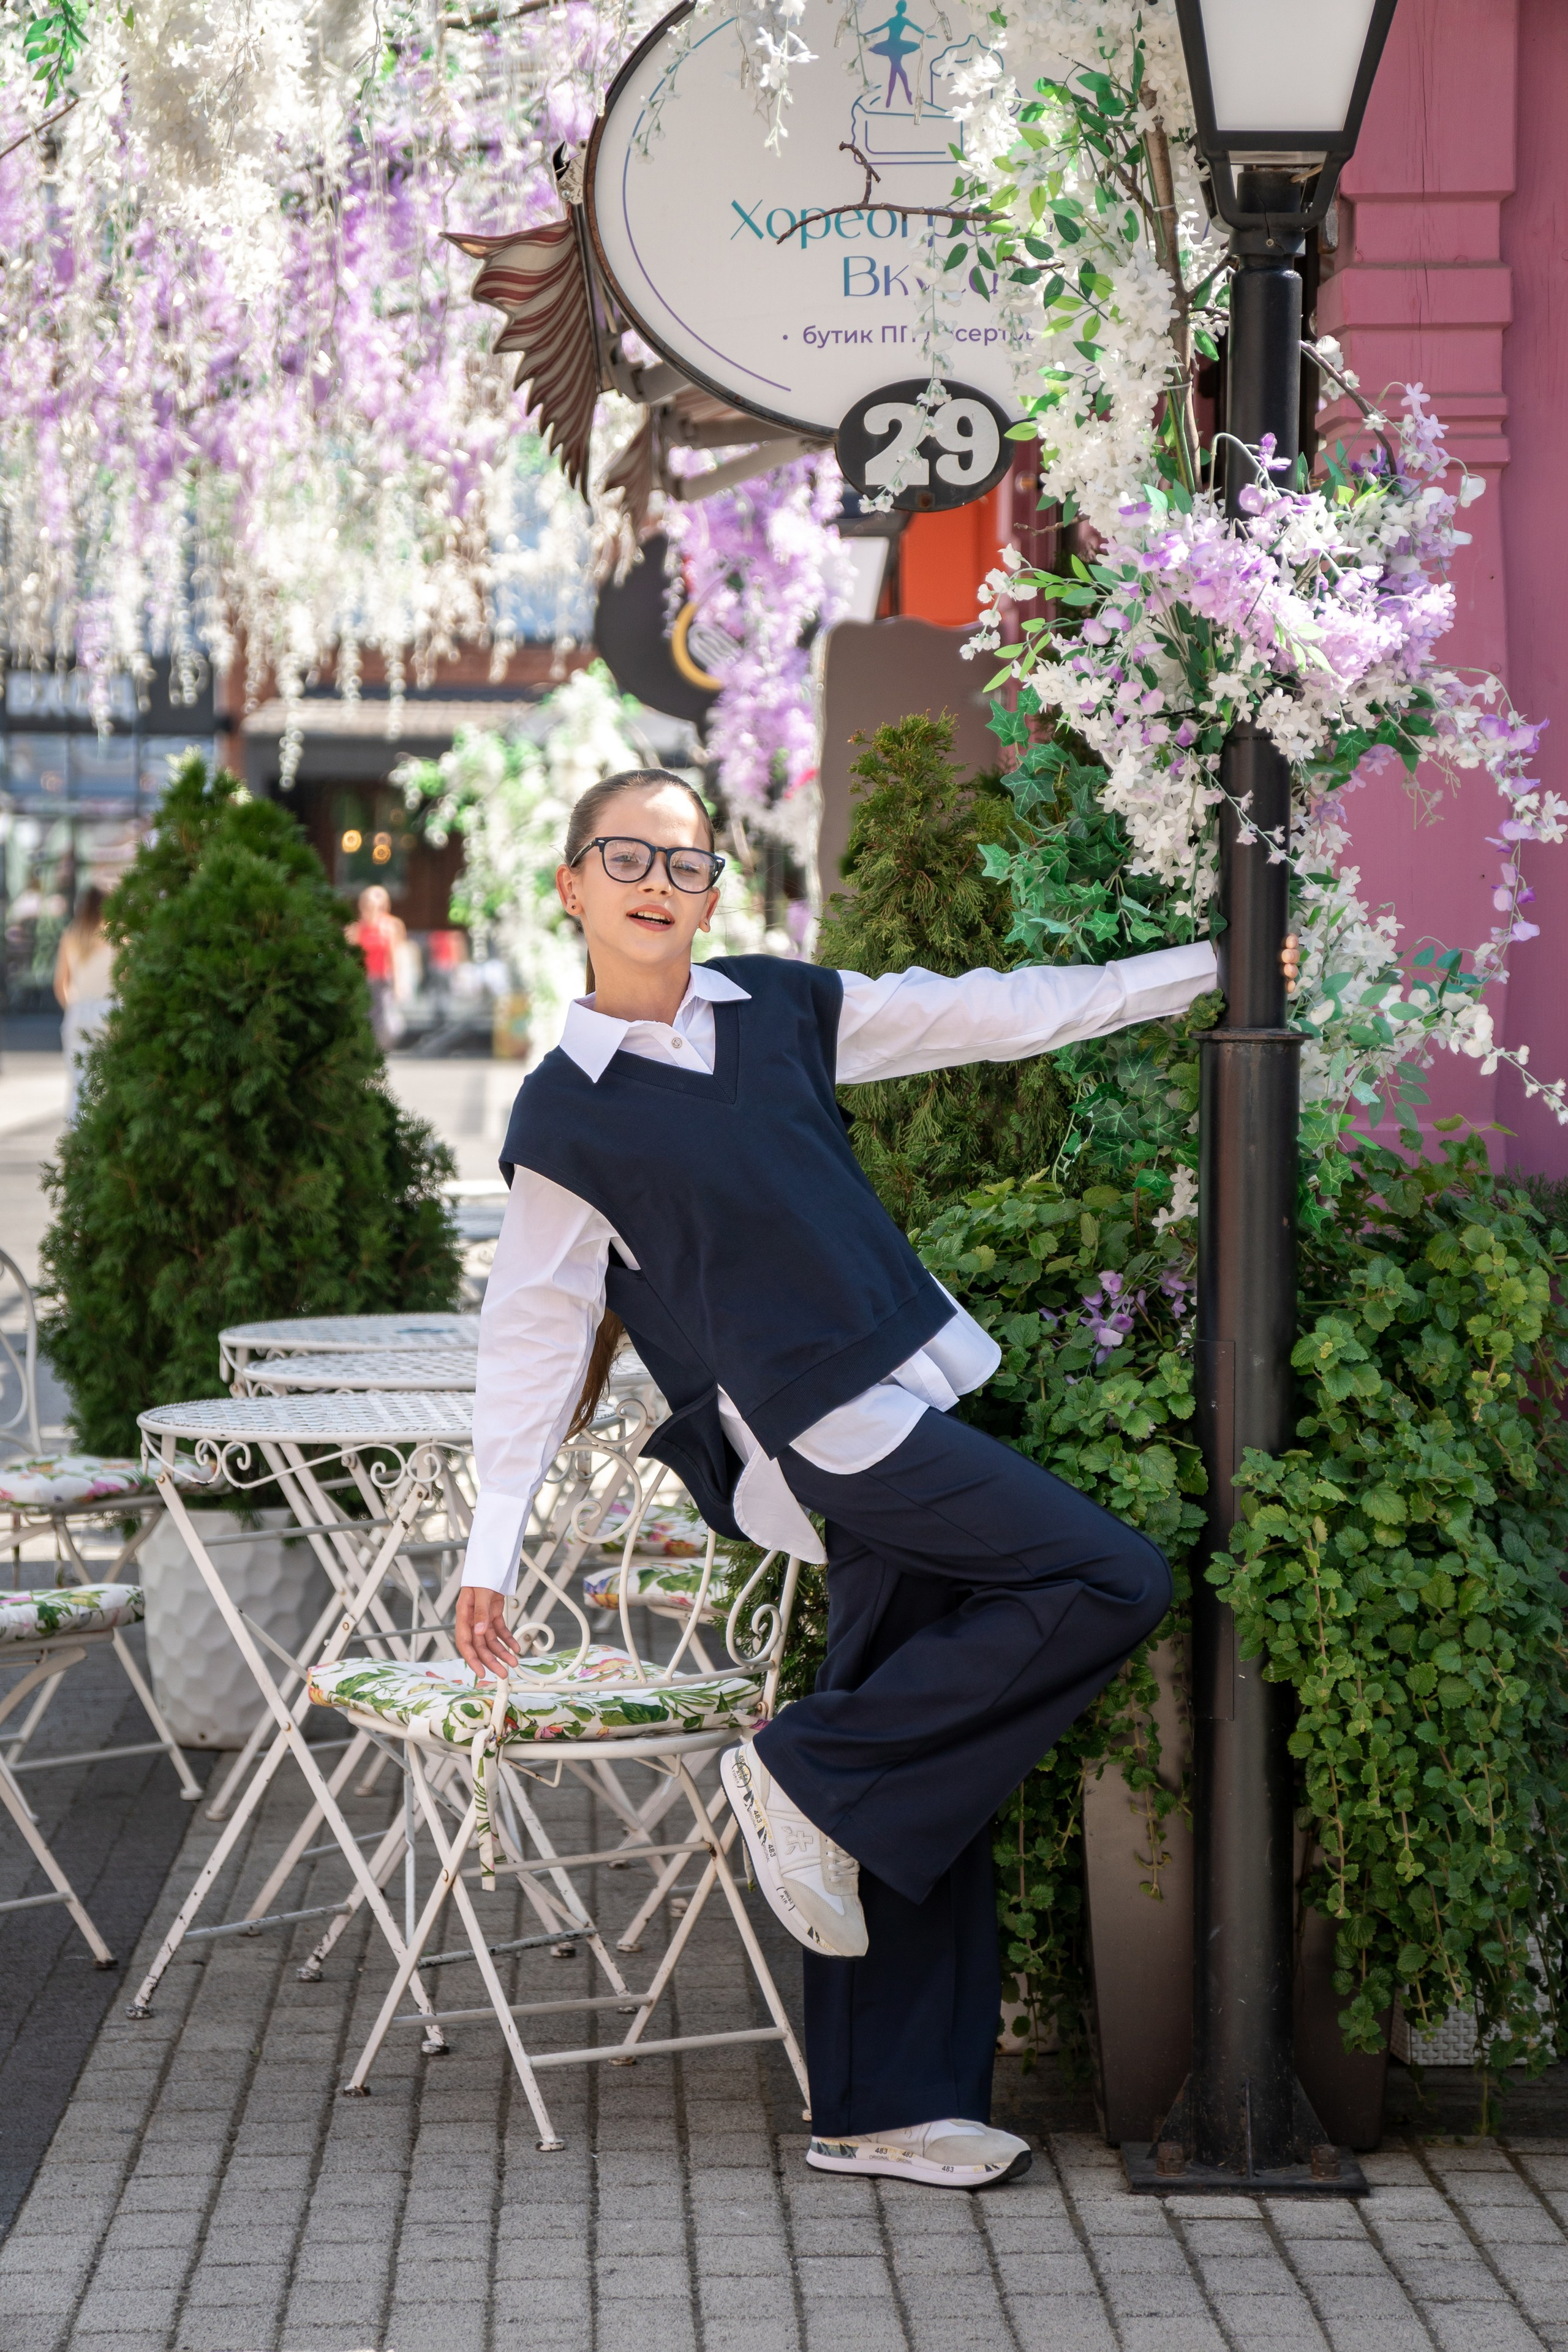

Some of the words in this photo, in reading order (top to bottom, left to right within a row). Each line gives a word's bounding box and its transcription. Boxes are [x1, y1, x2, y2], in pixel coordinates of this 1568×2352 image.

[843, 255, 999, 297] Вка
[802, 325, 873, 349] бутик
[863, 398, 1000, 486] 29
[753, 1810, 763, 1823] 483
[767, 1844, 776, 1858] 483
[779, 1894, 788, 1905] AIR
